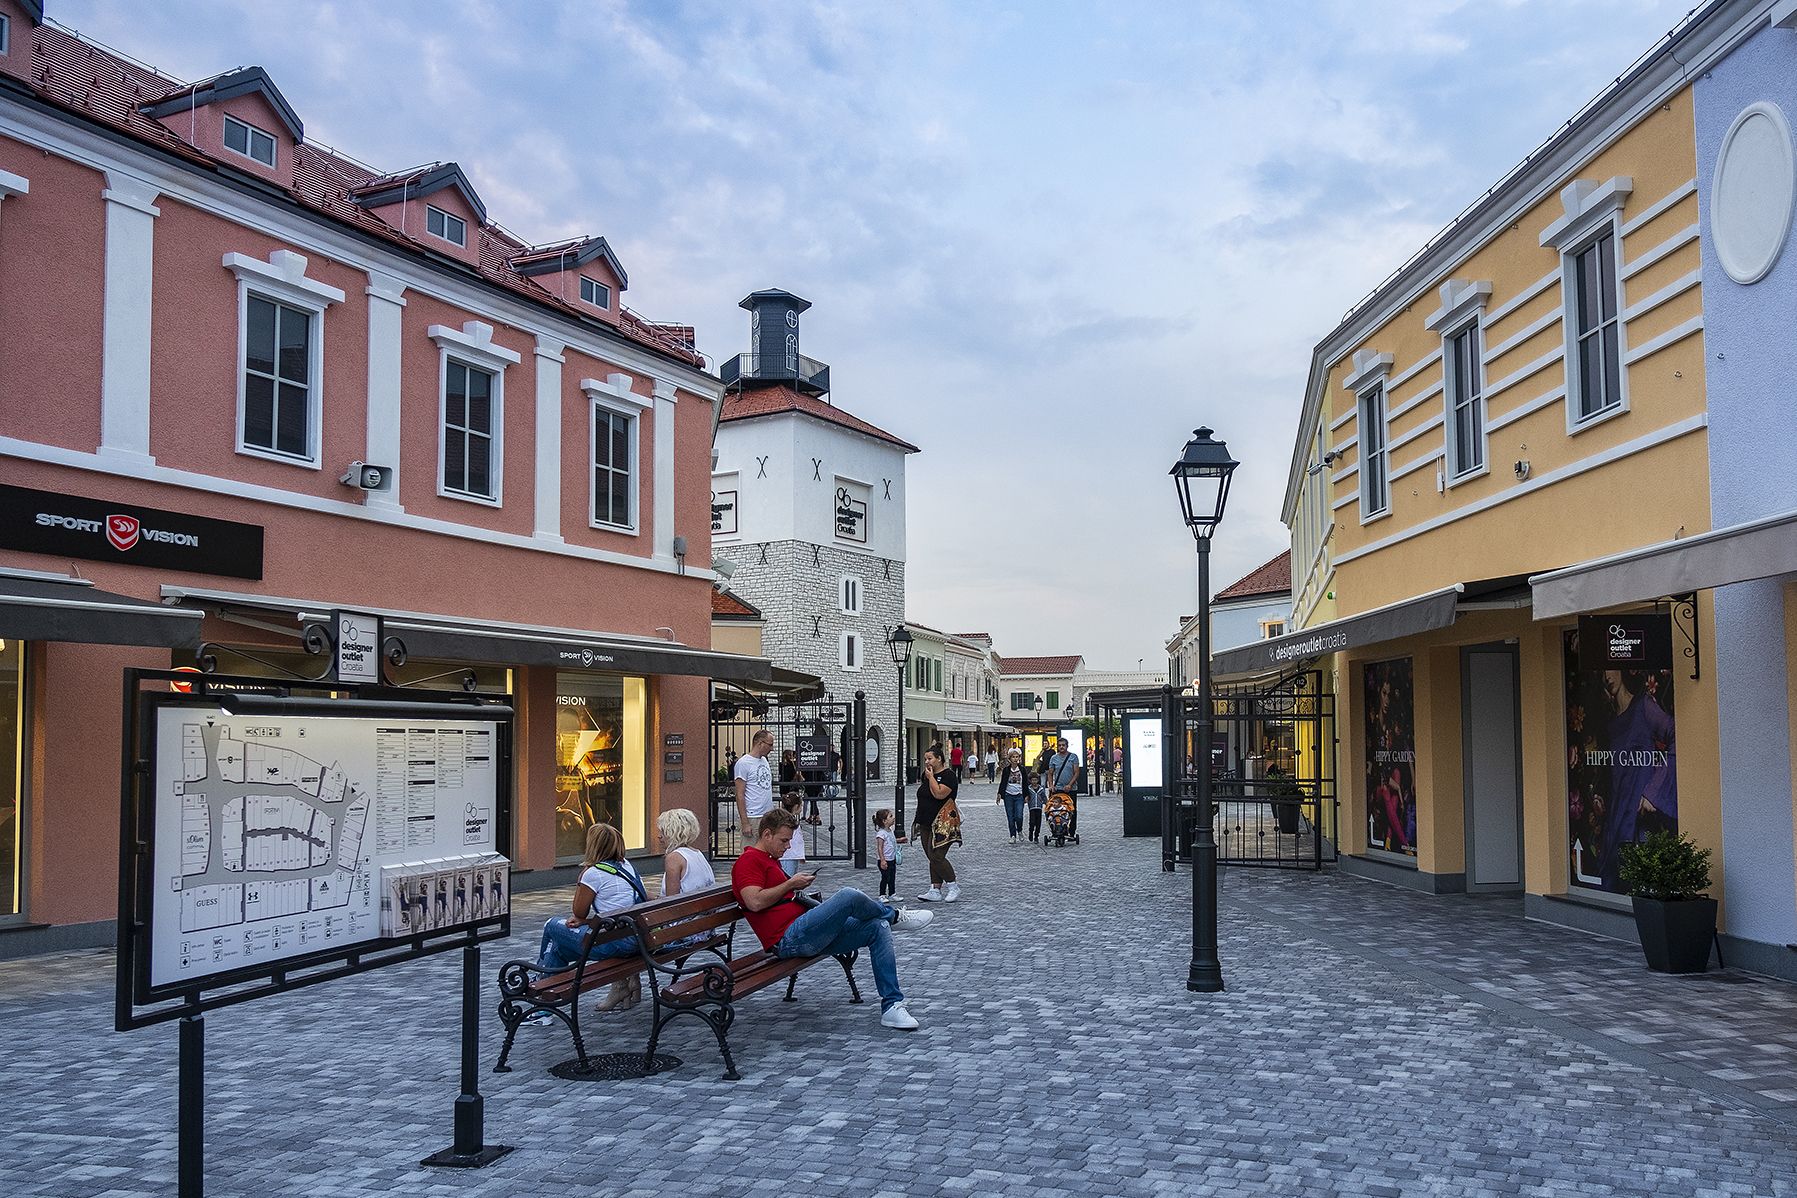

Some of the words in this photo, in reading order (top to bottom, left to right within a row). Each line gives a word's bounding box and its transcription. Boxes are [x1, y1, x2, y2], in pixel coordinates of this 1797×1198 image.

[36, 513, 102, 532] SPORT
[142, 528, 199, 547] VISION
[341, 641, 374, 653] designer
[341, 652, 364, 662] outlet
[560, 652, 581, 660] SPORT
[341, 661, 363, 671] Croatia
[1375, 750, 1391, 762] HIPPY
[1586, 750, 1616, 766] HIPPY
[1618, 750, 1668, 767] GARDEN
[465, 818, 488, 826] designer
[465, 826, 481, 834] outlet
[196, 898, 218, 907] GUESS
